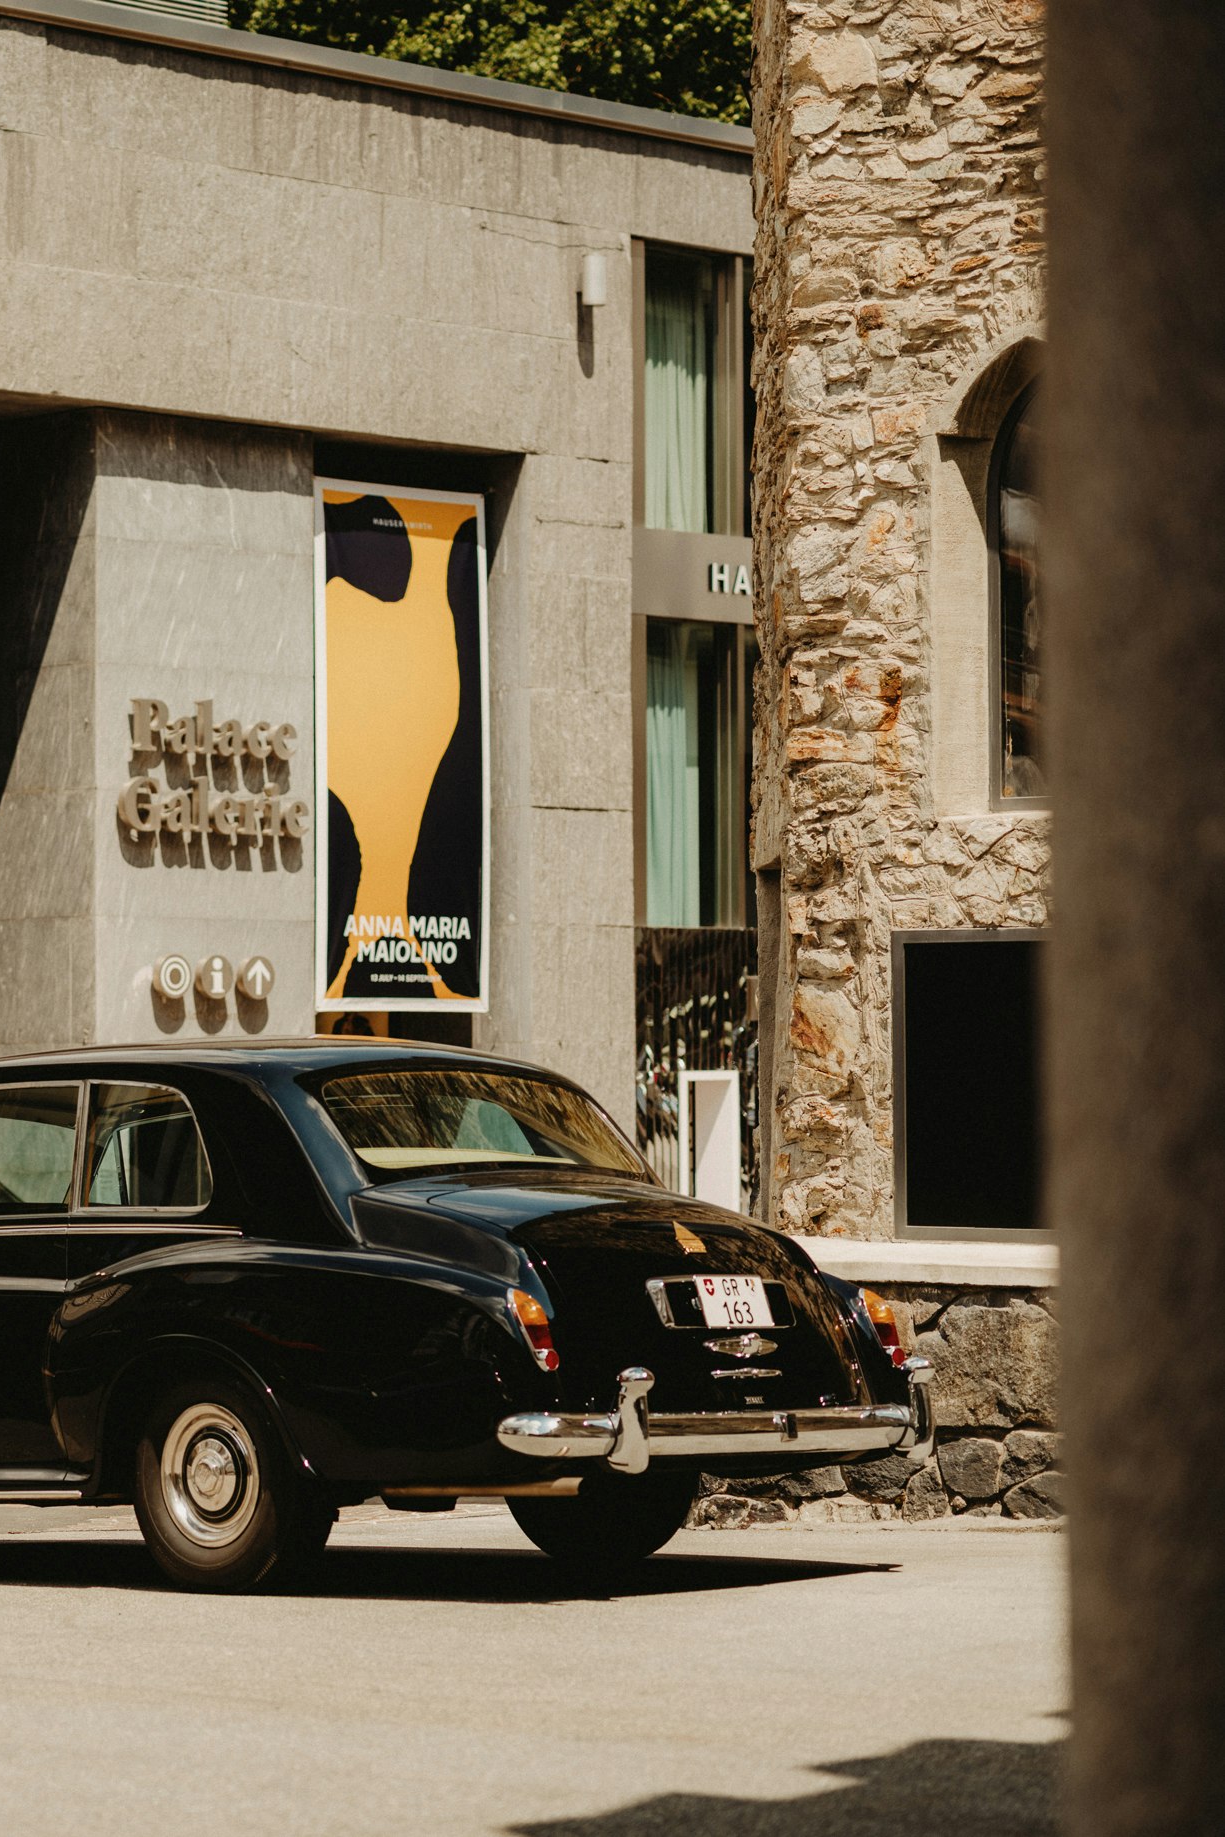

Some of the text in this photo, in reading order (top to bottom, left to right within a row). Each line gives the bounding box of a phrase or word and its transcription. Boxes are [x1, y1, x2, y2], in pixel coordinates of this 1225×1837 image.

[129, 698, 298, 761] Palace
[118, 776, 310, 838] Galerie
[343, 914, 471, 940] ANNA MARIA
[357, 939, 458, 964] MAIOLINO
[721, 1278, 741, 1297] GR
[722, 1300, 755, 1325] 163
